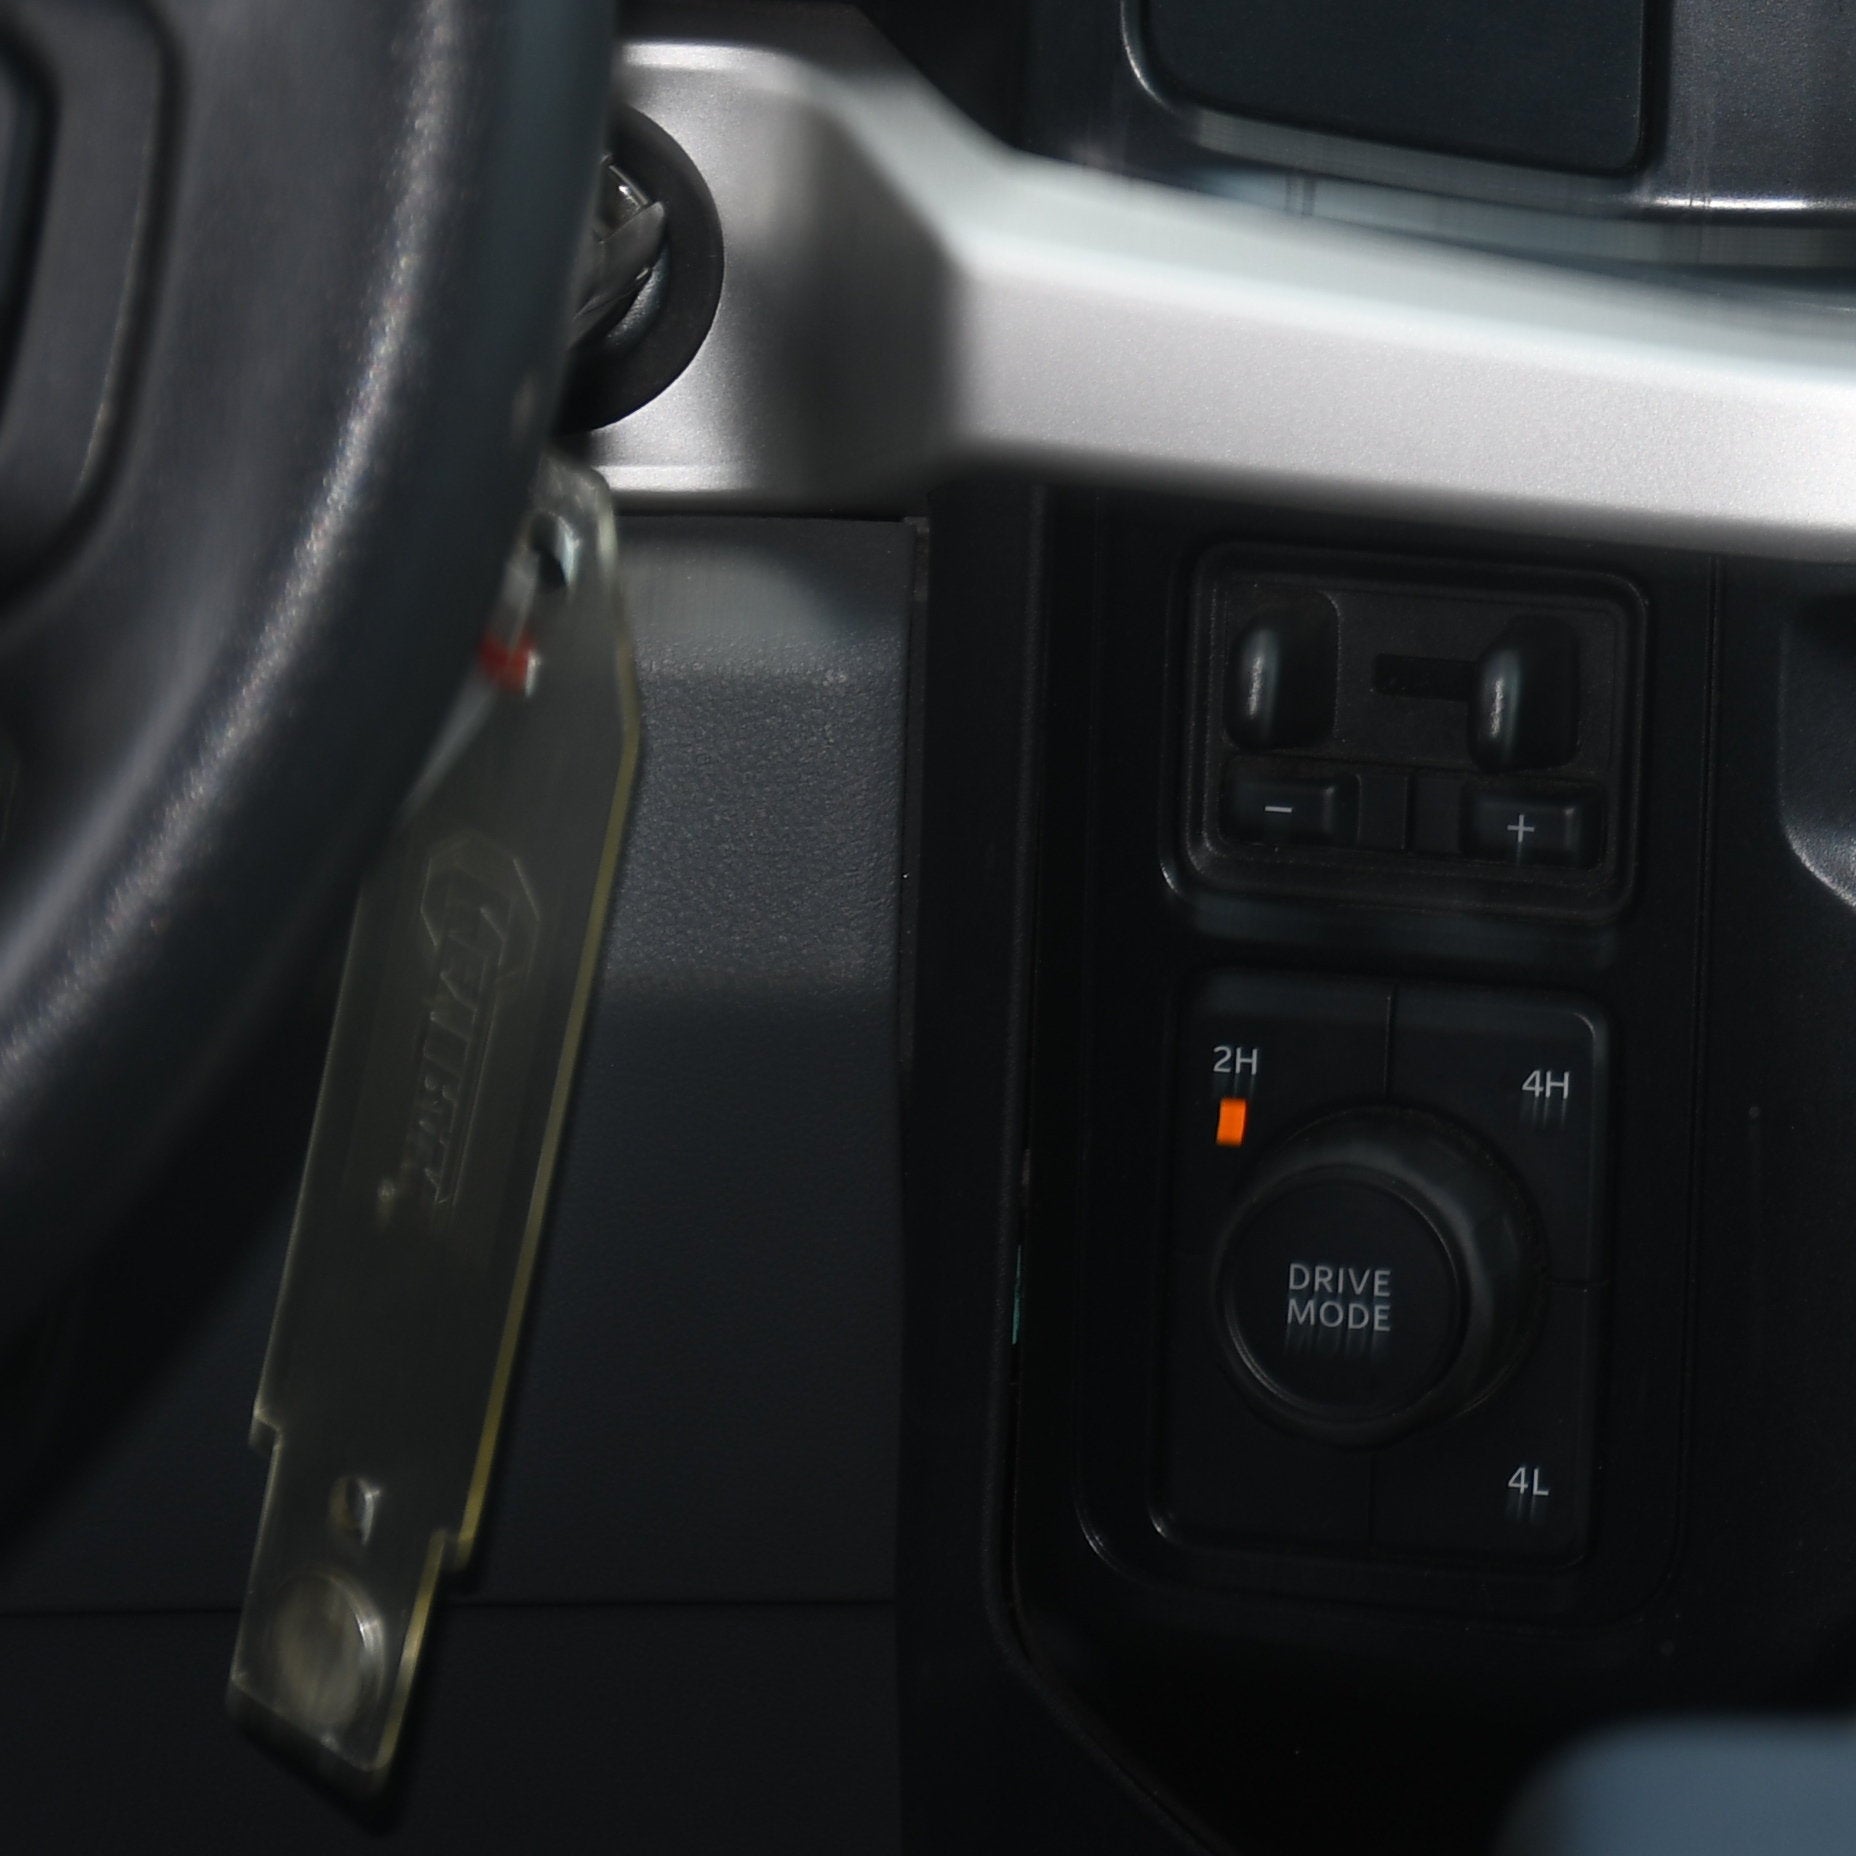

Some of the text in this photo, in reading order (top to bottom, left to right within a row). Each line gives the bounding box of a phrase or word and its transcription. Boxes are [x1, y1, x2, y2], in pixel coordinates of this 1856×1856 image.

[1213, 1046, 1258, 1075] 2H
[1521, 1070, 1570, 1099] 4H
[1289, 1263, 1391, 1297] DRIVE
[1287, 1298, 1391, 1332] MODE
[1507, 1467, 1549, 1496] 4L
